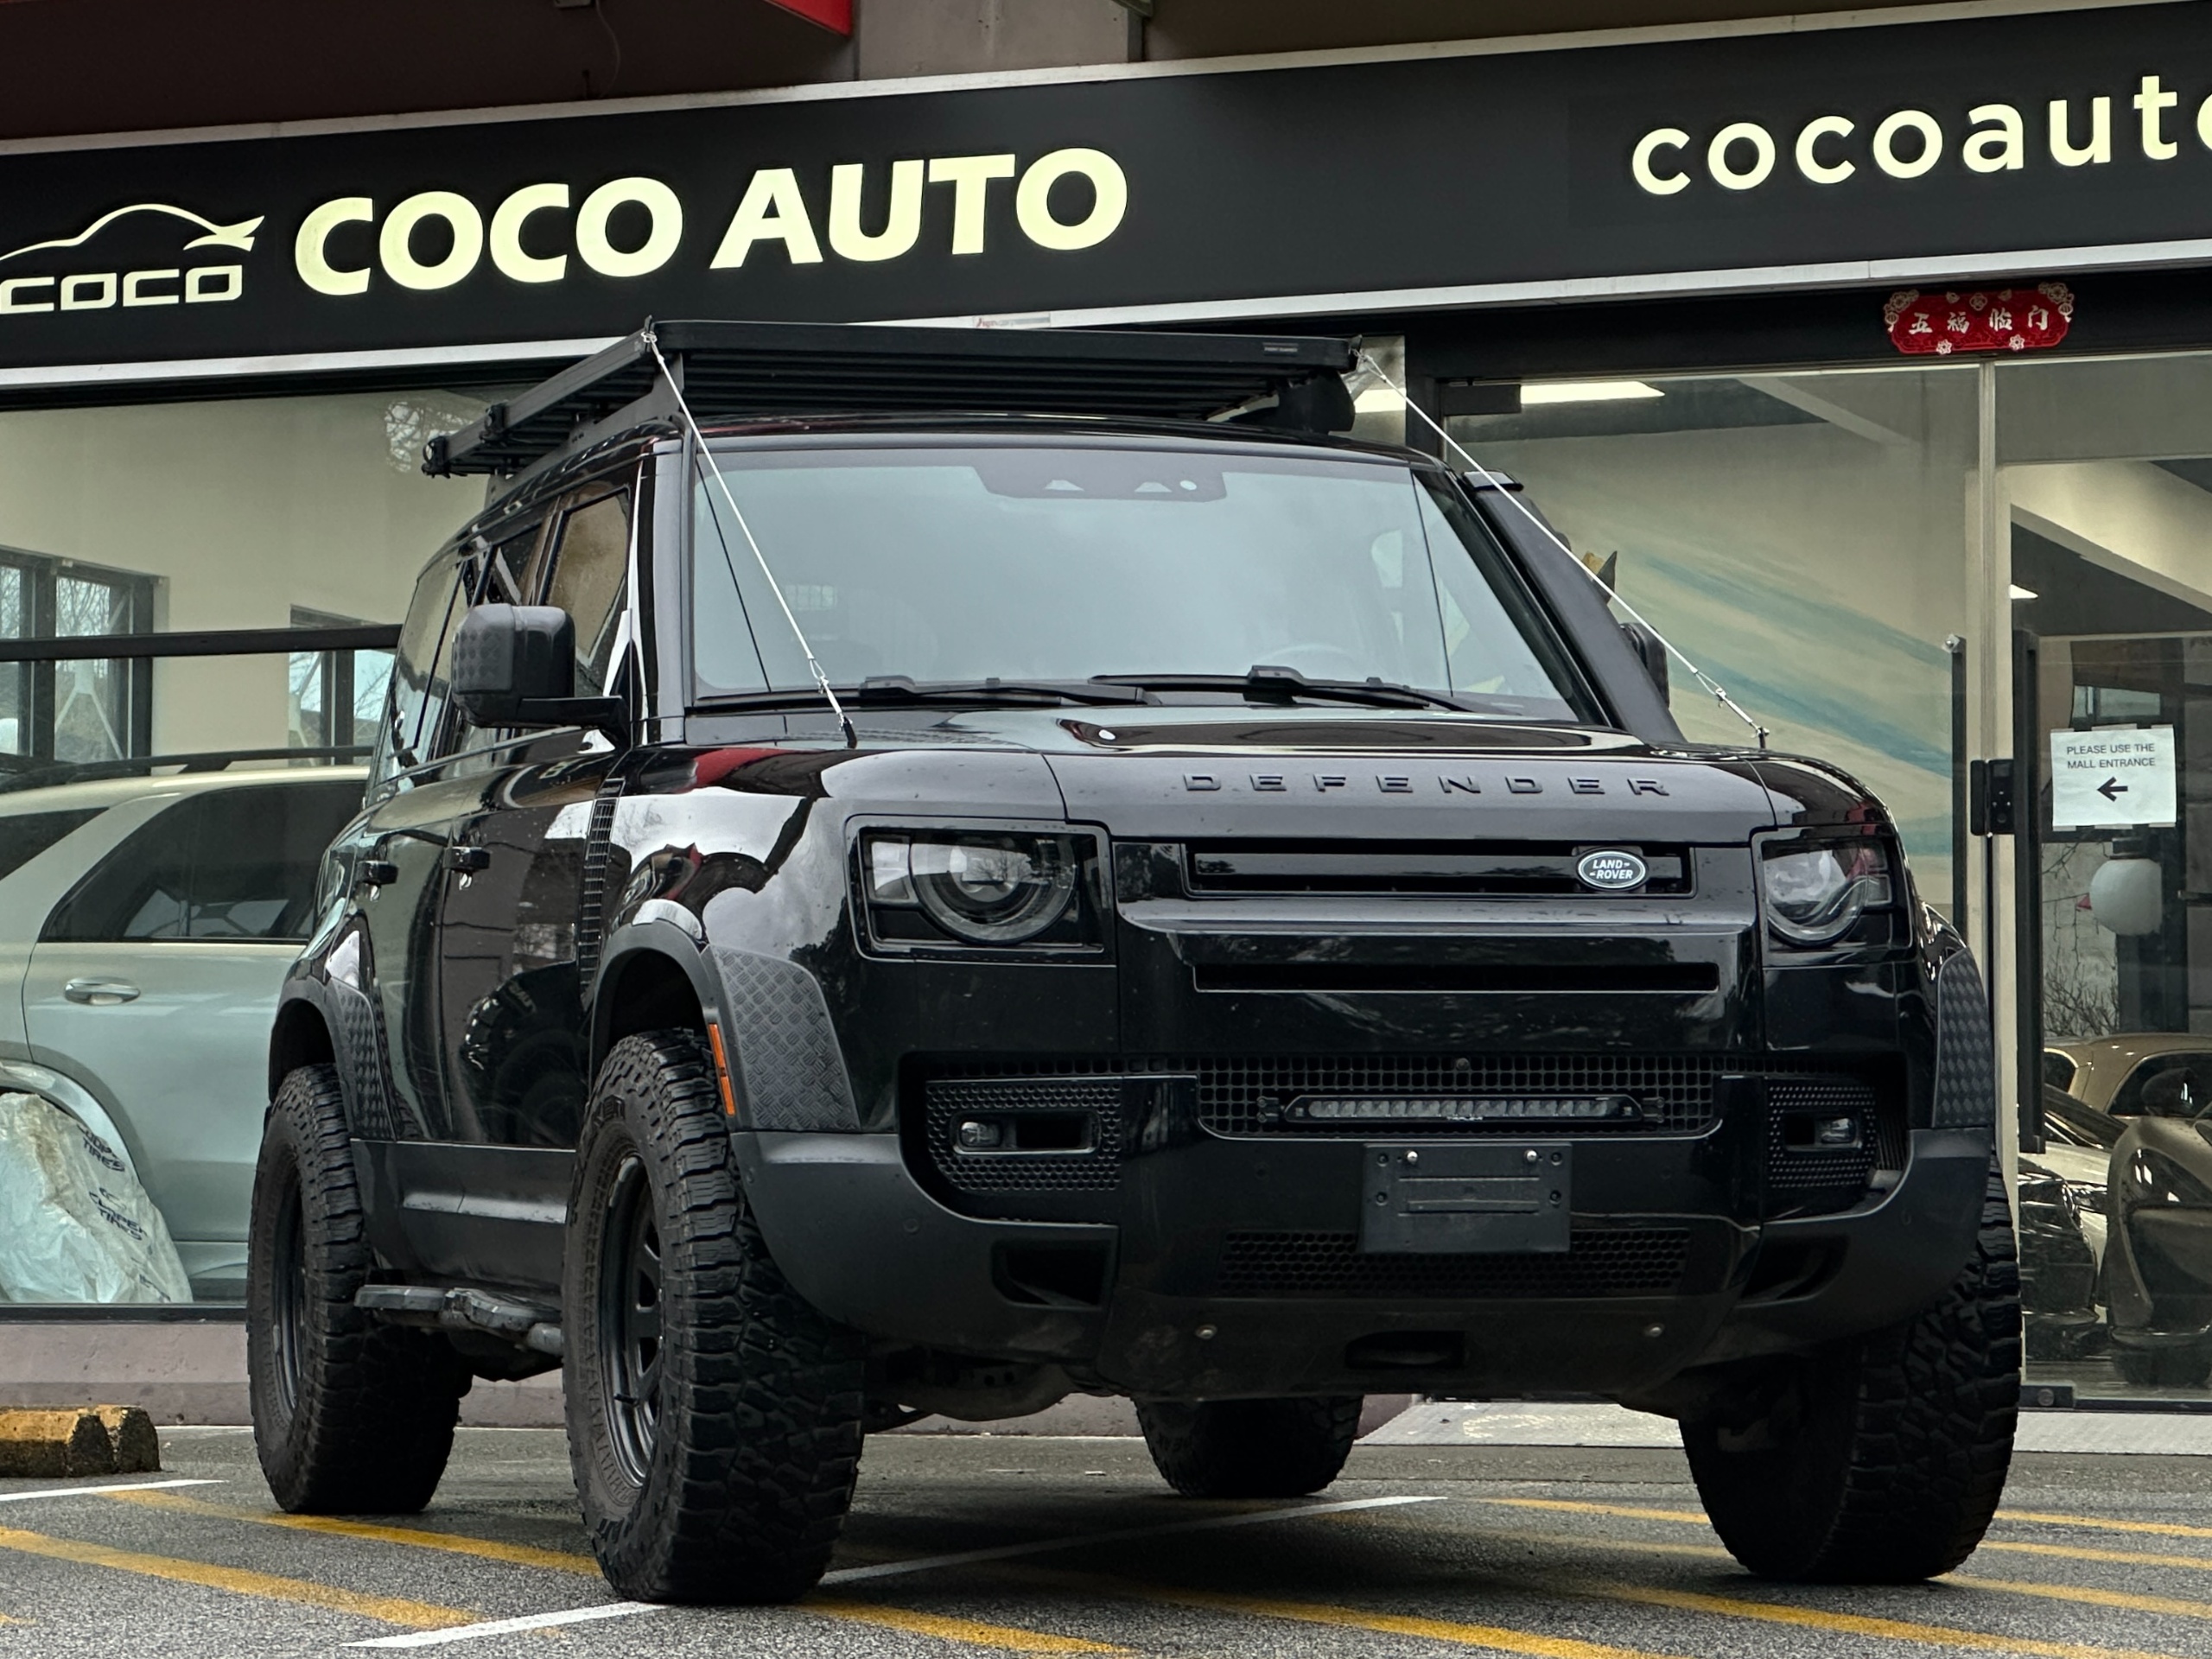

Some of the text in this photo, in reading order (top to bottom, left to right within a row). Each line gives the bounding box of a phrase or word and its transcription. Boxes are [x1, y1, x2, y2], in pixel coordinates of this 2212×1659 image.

[1633, 76, 2212, 195] cocoaut
[296, 148, 1128, 296] COCO AUTO
[0, 264, 243, 315] COCO
[1909, 305, 2049, 334] 五福临门
[2066, 743, 2155, 755] PLEASE USE THE
[2067, 757, 2156, 769] MALL ENTRANCE
[1183, 772, 1670, 797] DEFENDER
[1592, 859, 1624, 869] LAND
[1596, 869, 1634, 880] ROVER
